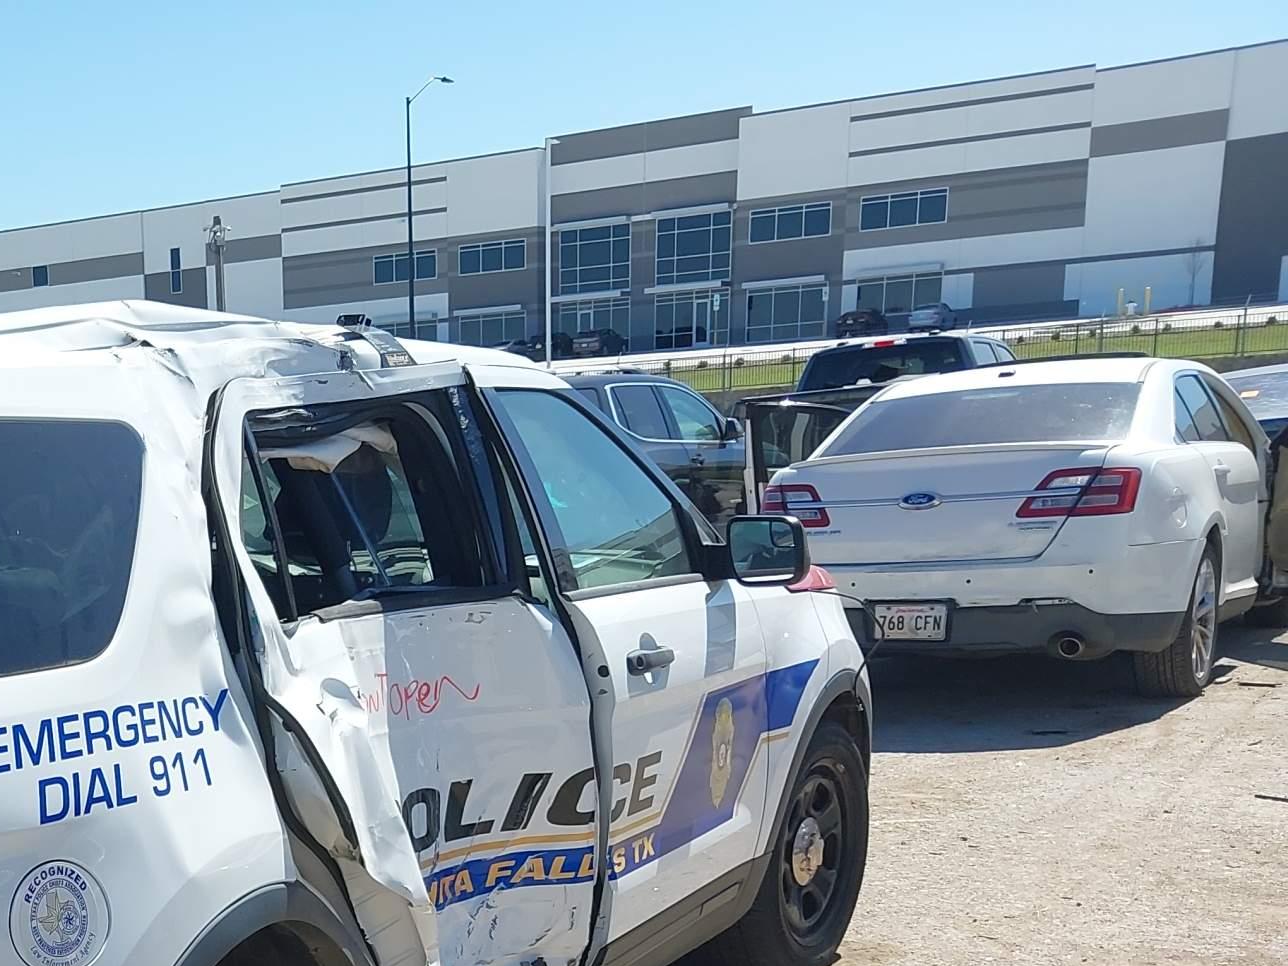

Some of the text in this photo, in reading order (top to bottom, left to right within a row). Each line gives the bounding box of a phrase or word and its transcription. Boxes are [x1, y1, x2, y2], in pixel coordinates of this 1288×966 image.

[879, 615, 942, 631] 768 CFN
[38, 747, 213, 826] DIAL 911
[394, 750, 663, 852] OLICE
[631, 832, 655, 864] TX
[24, 865, 88, 905] RECOGNIZED
